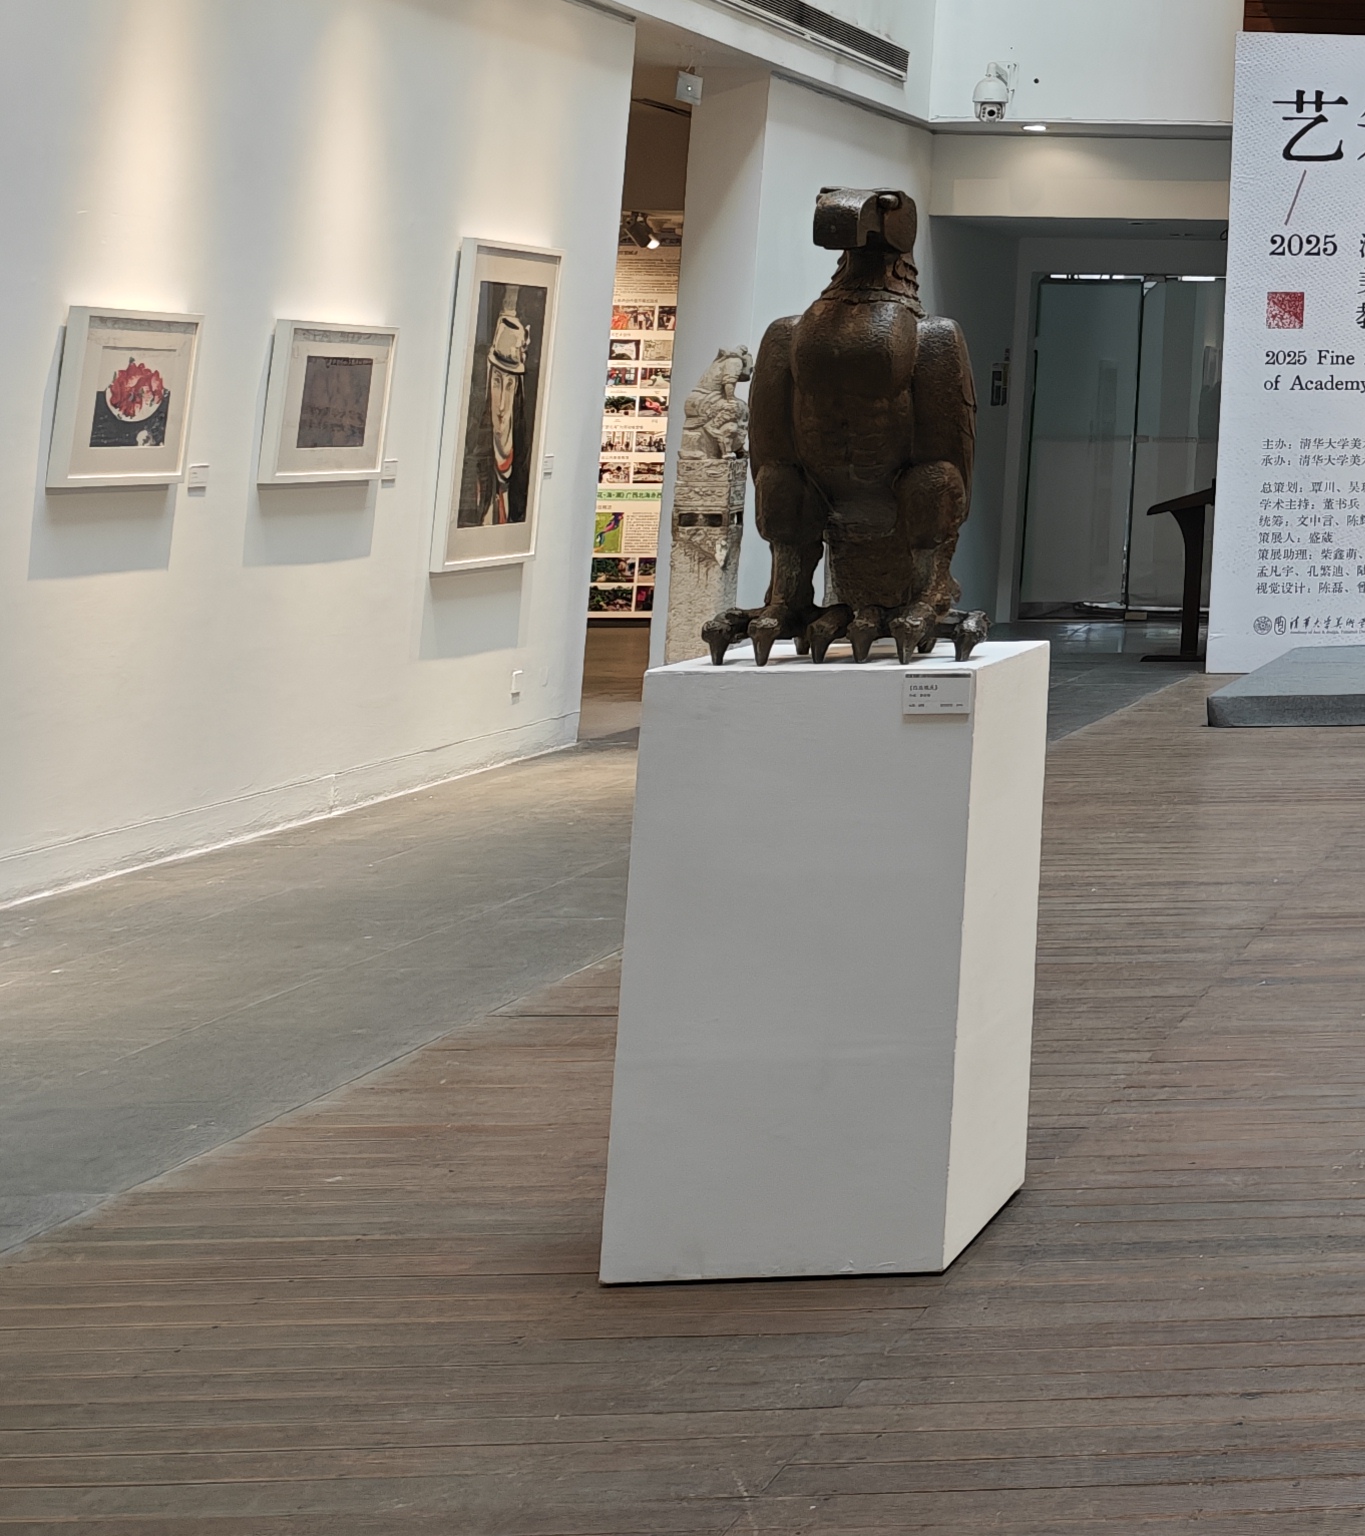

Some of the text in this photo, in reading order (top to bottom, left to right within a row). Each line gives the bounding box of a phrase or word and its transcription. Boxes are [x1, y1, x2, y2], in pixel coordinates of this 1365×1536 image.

[1269, 233, 1338, 258] 2025
[1264, 350, 1308, 365] 2025
[1316, 349, 1356, 365] Fine
[1263, 375, 1282, 391] of
